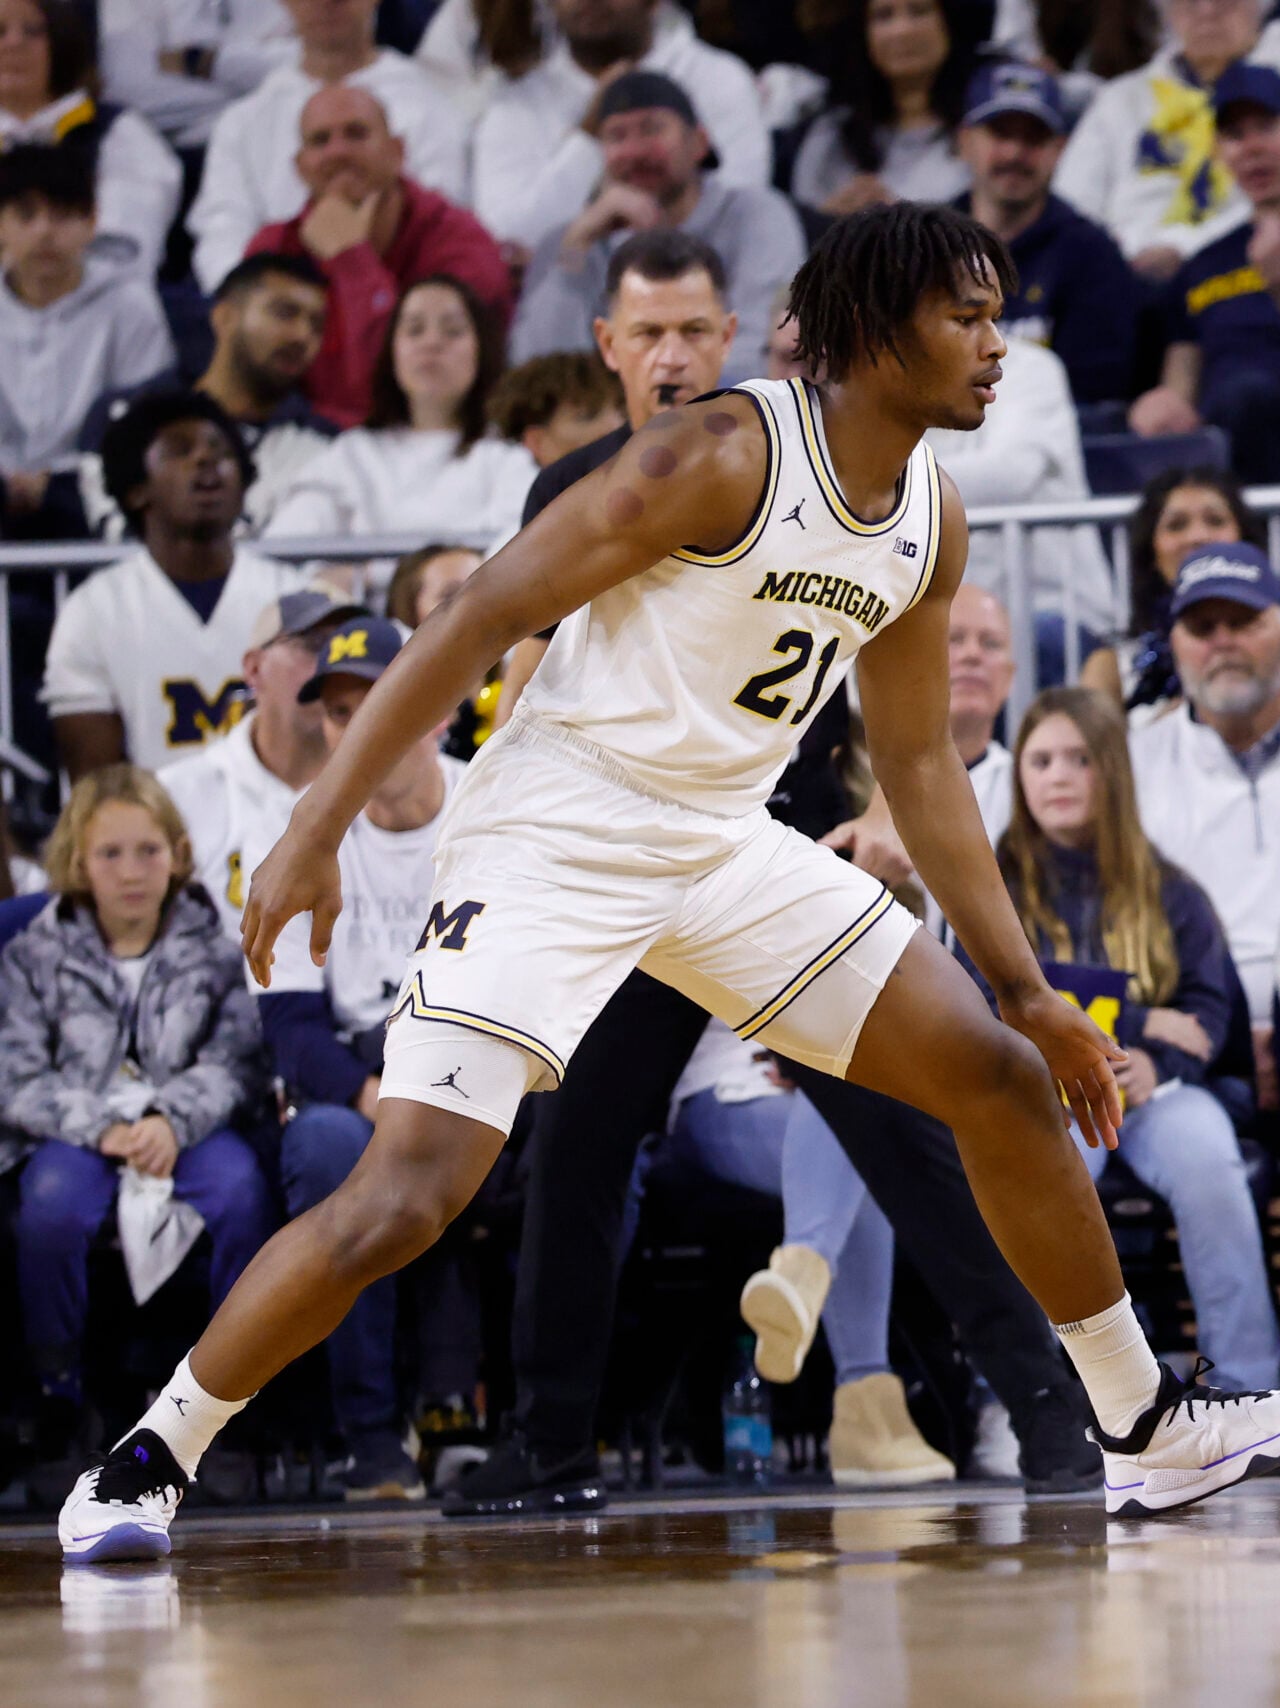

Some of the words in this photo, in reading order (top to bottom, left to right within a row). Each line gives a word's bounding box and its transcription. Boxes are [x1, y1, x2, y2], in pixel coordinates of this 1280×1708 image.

[752, 571, 890, 633] MICHIGAN
[326, 629, 369, 664] M
[731, 628, 841, 728] 21
[161, 676, 251, 749] M
[414, 899, 487, 954] M
